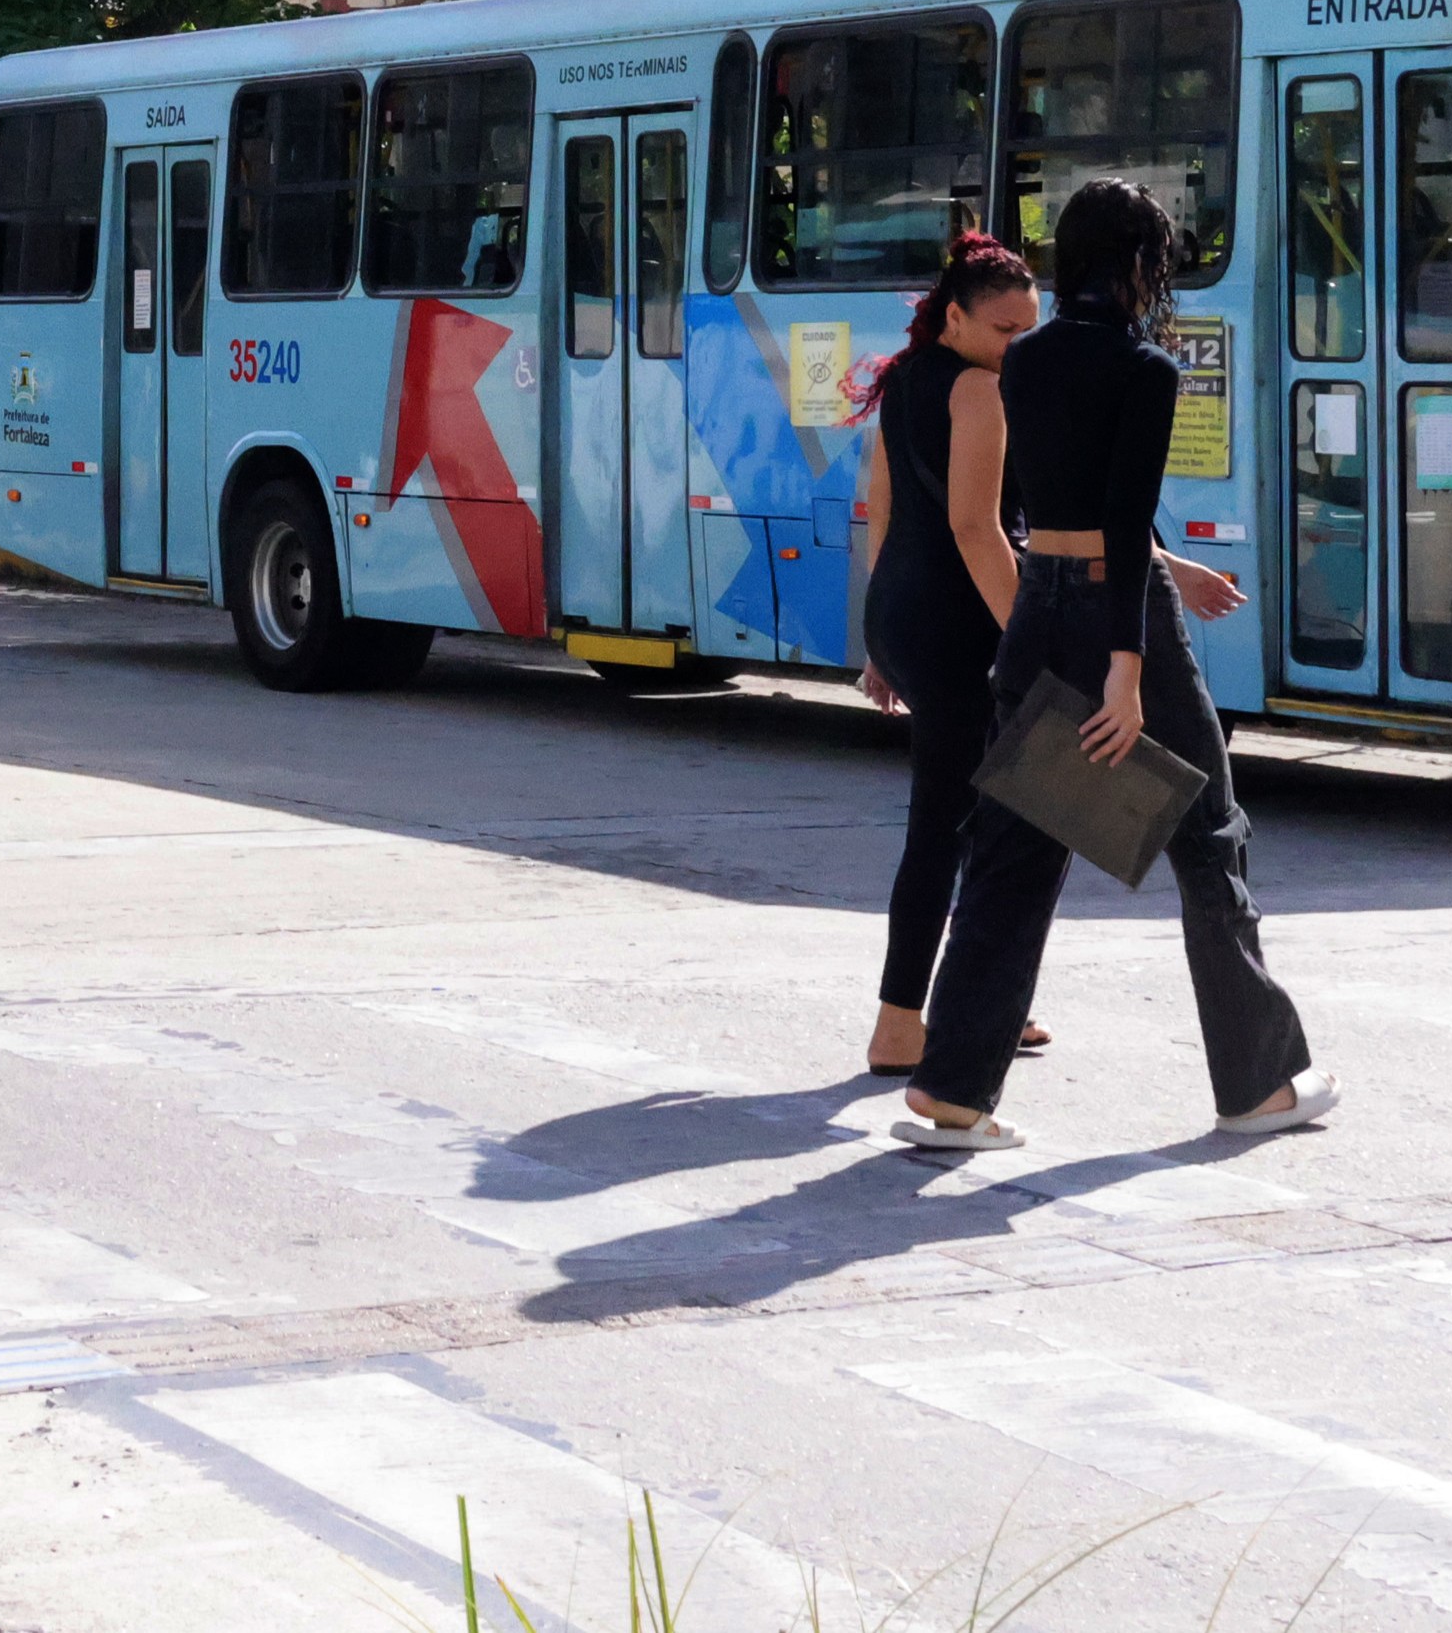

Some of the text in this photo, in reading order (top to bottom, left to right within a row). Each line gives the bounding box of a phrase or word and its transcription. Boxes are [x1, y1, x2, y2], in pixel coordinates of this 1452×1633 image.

[559, 65, 584, 85] USO
[588, 62, 614, 81] NOS
[145, 100, 186, 130] SAÍDA
[228, 338, 300, 385] 35240
[3, 408, 50, 425] Prefeitura de
[3, 424, 50, 447] Fortaleza
